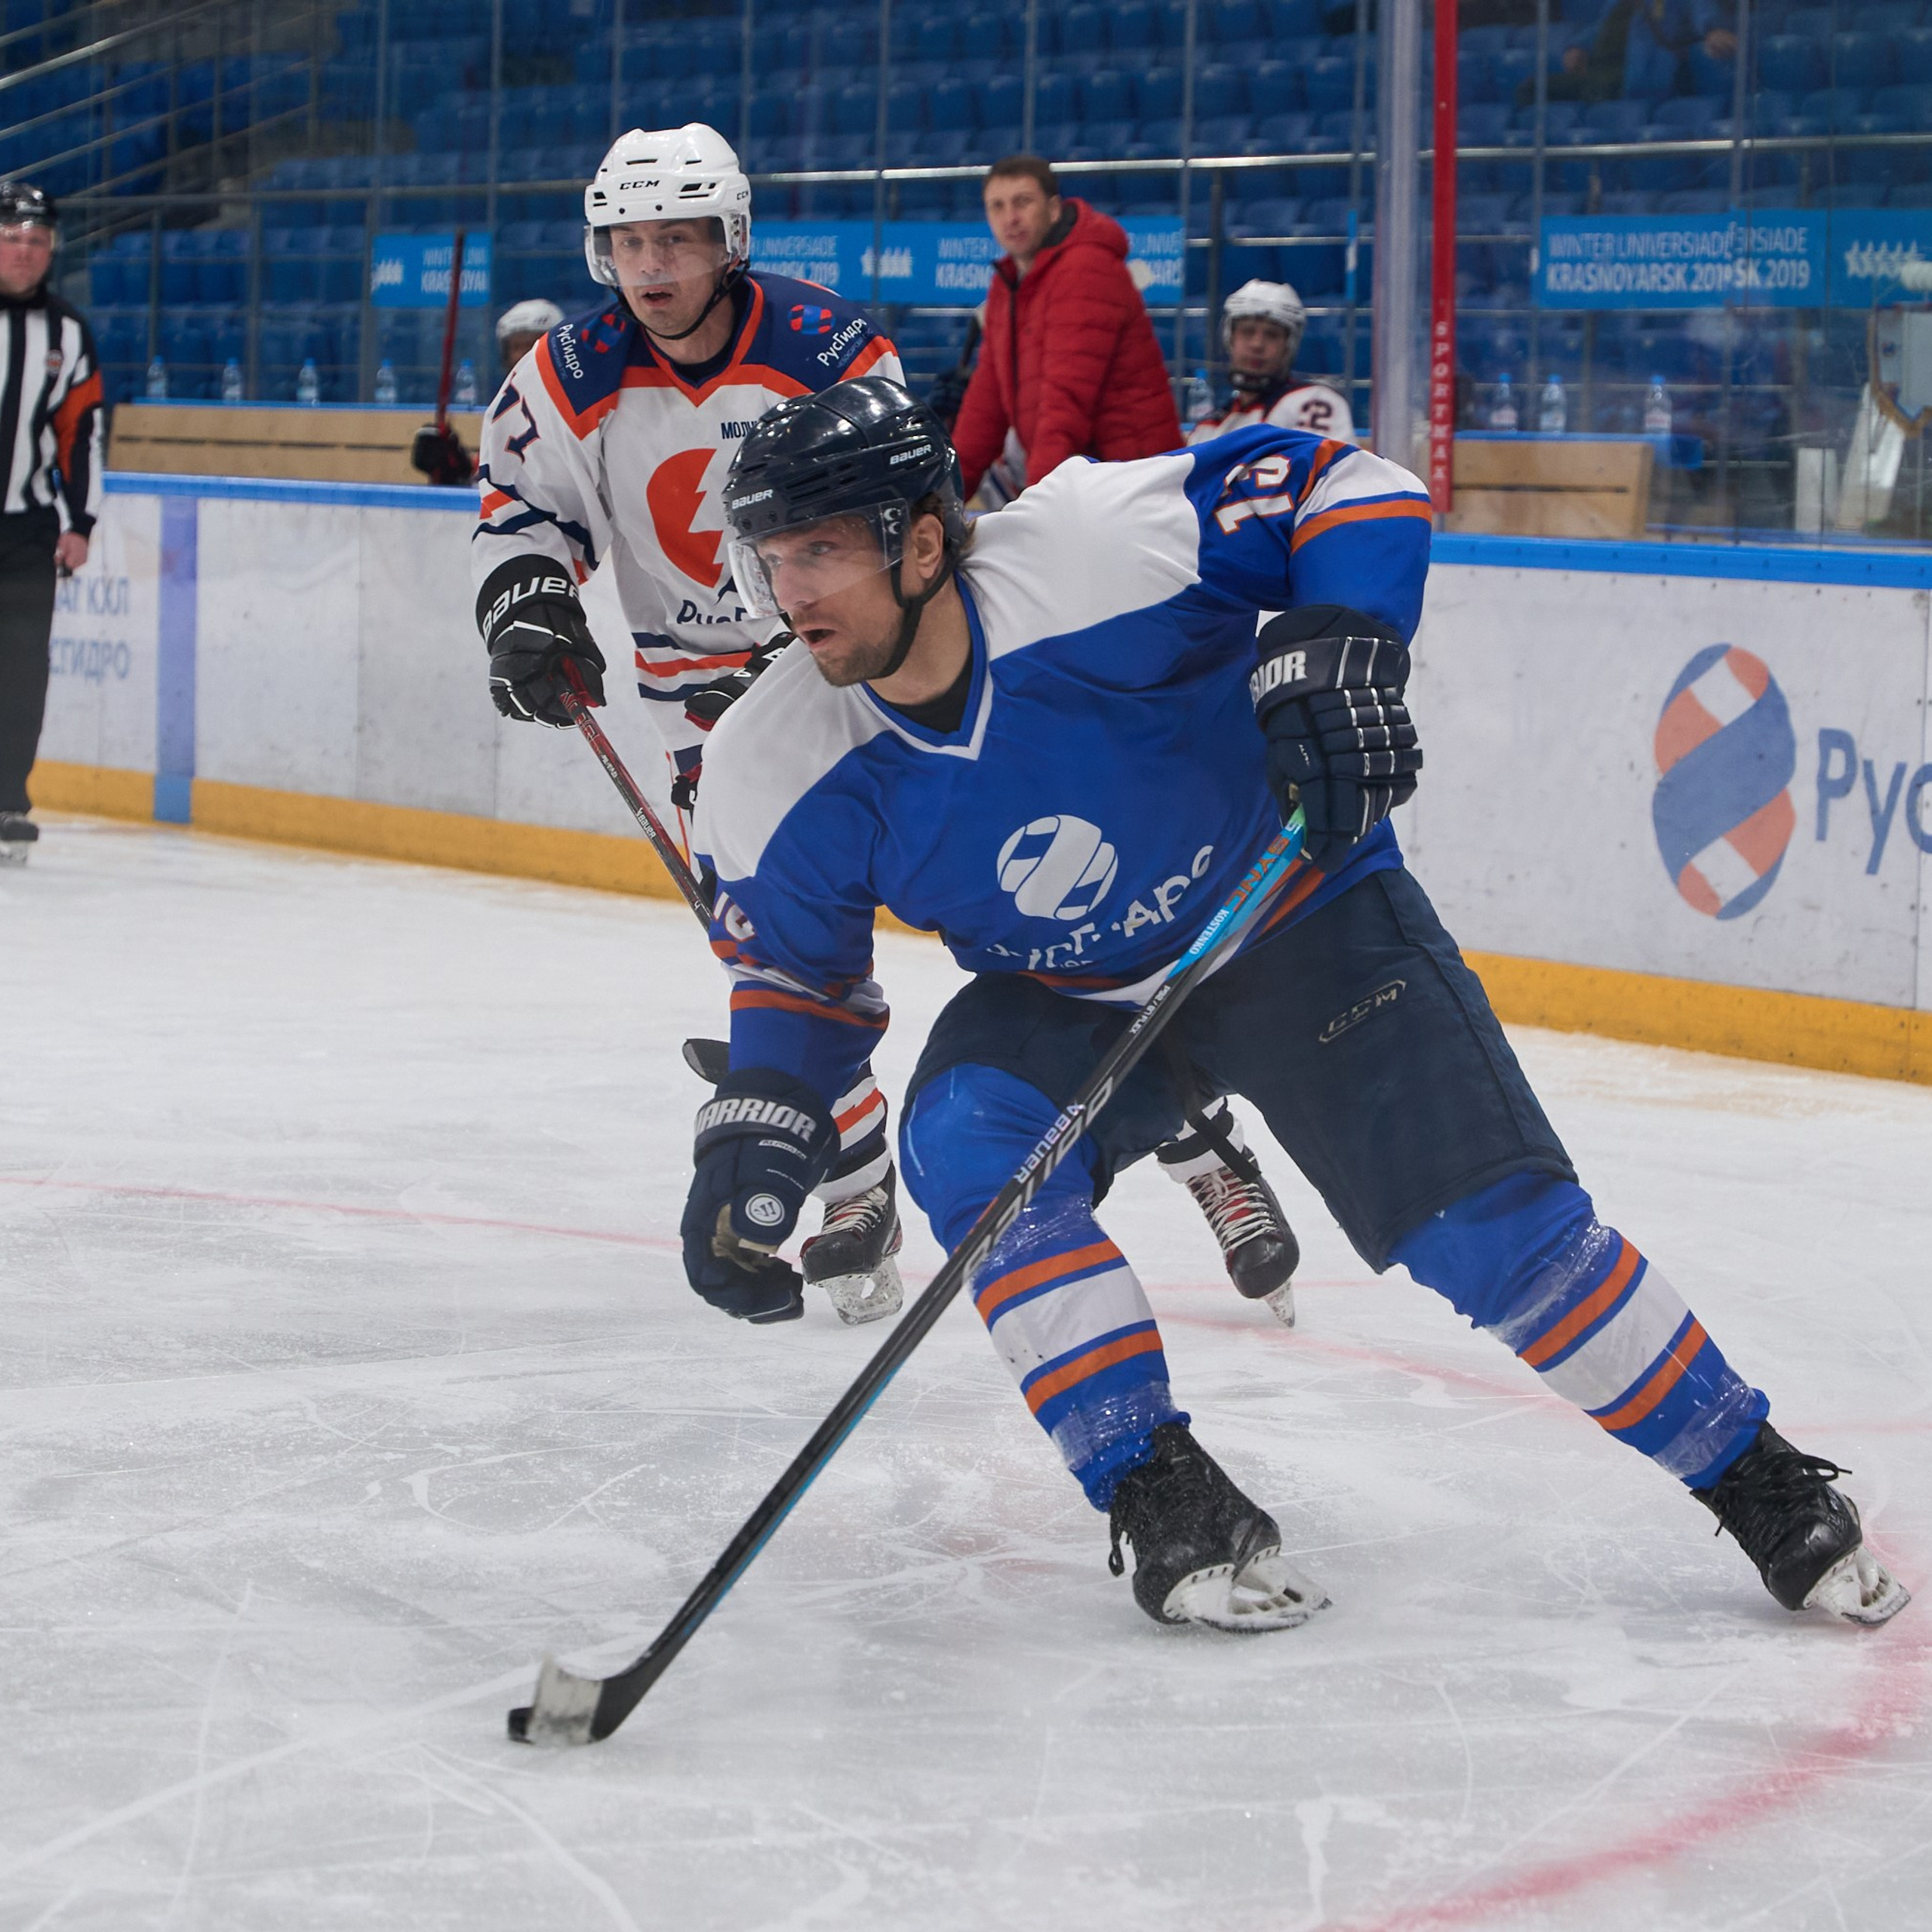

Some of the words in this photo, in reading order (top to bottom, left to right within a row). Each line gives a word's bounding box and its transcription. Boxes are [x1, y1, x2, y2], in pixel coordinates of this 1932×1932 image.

[619, 180, 660, 190] CCM
[556, 323, 583, 379] РусГидро
[890, 444, 931, 465] BAUER
[731, 489, 773, 509] BAUER
[638, 813, 657, 838] BAUER
[1224, 834, 1290, 913] SYNC
[1189, 909, 1230, 955] KOSTENKO
[1328, 989, 1397, 1033] CCM
[1014, 1113, 1071, 1184] BAUER
